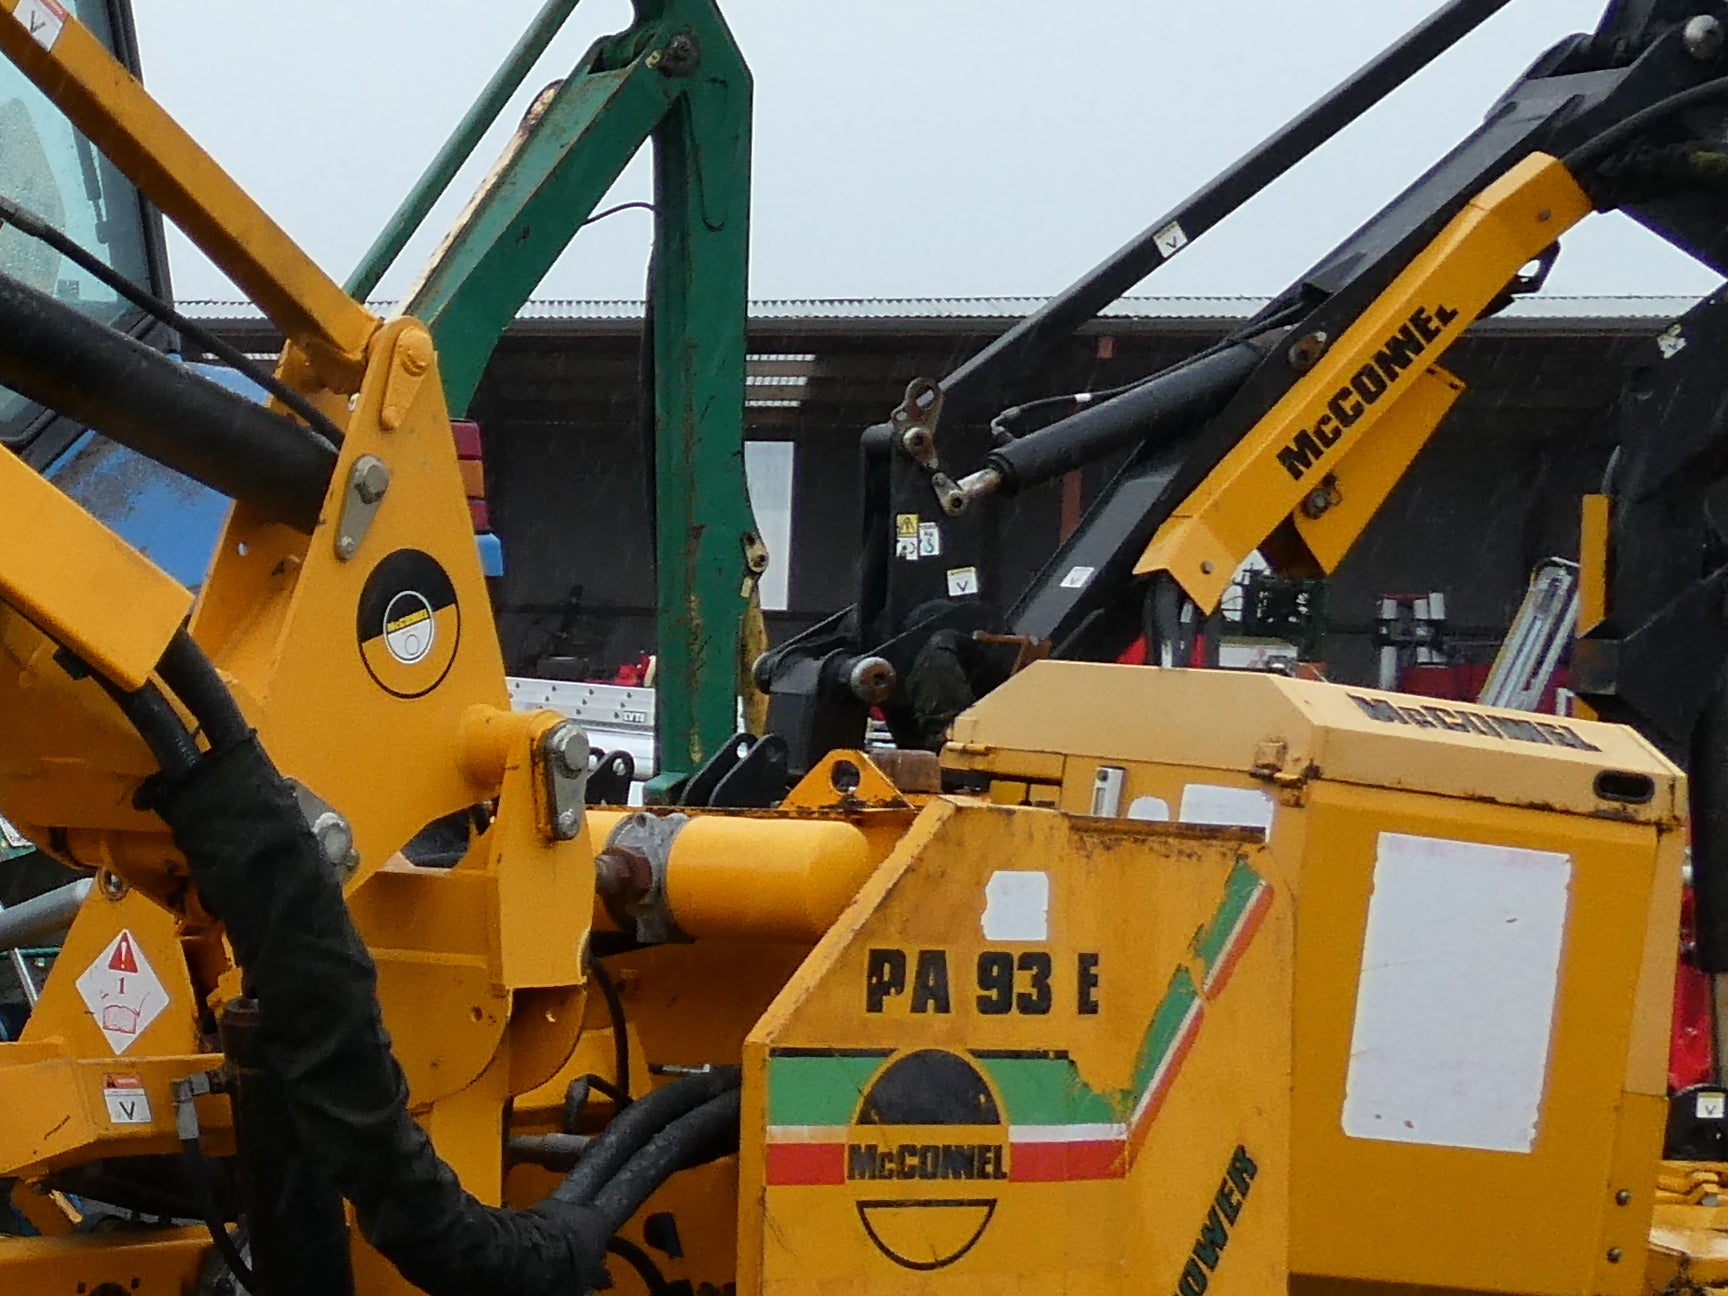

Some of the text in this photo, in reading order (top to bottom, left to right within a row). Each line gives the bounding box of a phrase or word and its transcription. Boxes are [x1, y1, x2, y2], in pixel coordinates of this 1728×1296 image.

[1275, 304, 1460, 481] McCONNEL
[865, 948, 1100, 1016] PA 93 E
[846, 1143, 1008, 1181] McCONNEL
